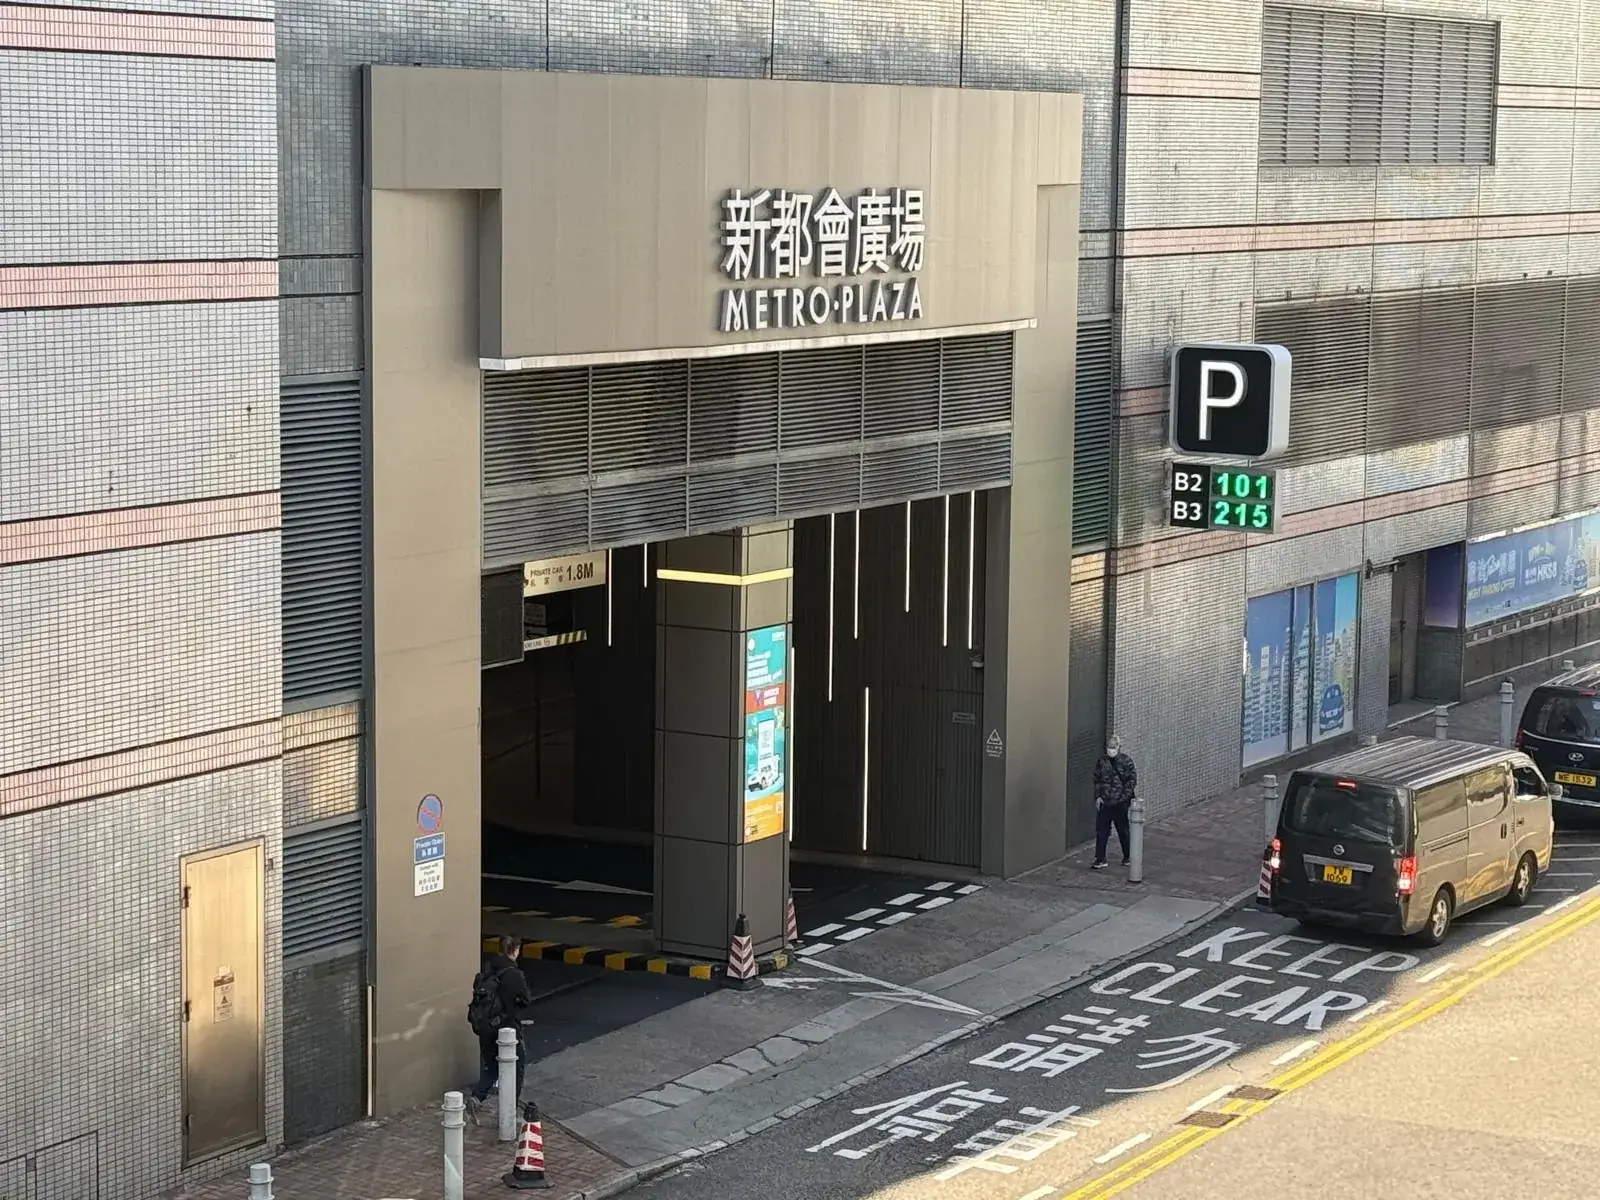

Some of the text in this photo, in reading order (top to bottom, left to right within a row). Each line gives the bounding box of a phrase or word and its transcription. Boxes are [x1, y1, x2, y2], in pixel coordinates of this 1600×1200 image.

[721, 186, 926, 281] 新都會廣場
[1198, 360, 1248, 441] P
[1173, 500, 1268, 528] B3 215
[1174, 472, 1268, 499] B2 101
[566, 561, 594, 582] 1.8M
[1176, 926, 1420, 984] KEEP
[1088, 961, 1370, 1030] CLEAR
[969, 1006, 1243, 1093] 請勿
[805, 1081, 1100, 1180] 停車
